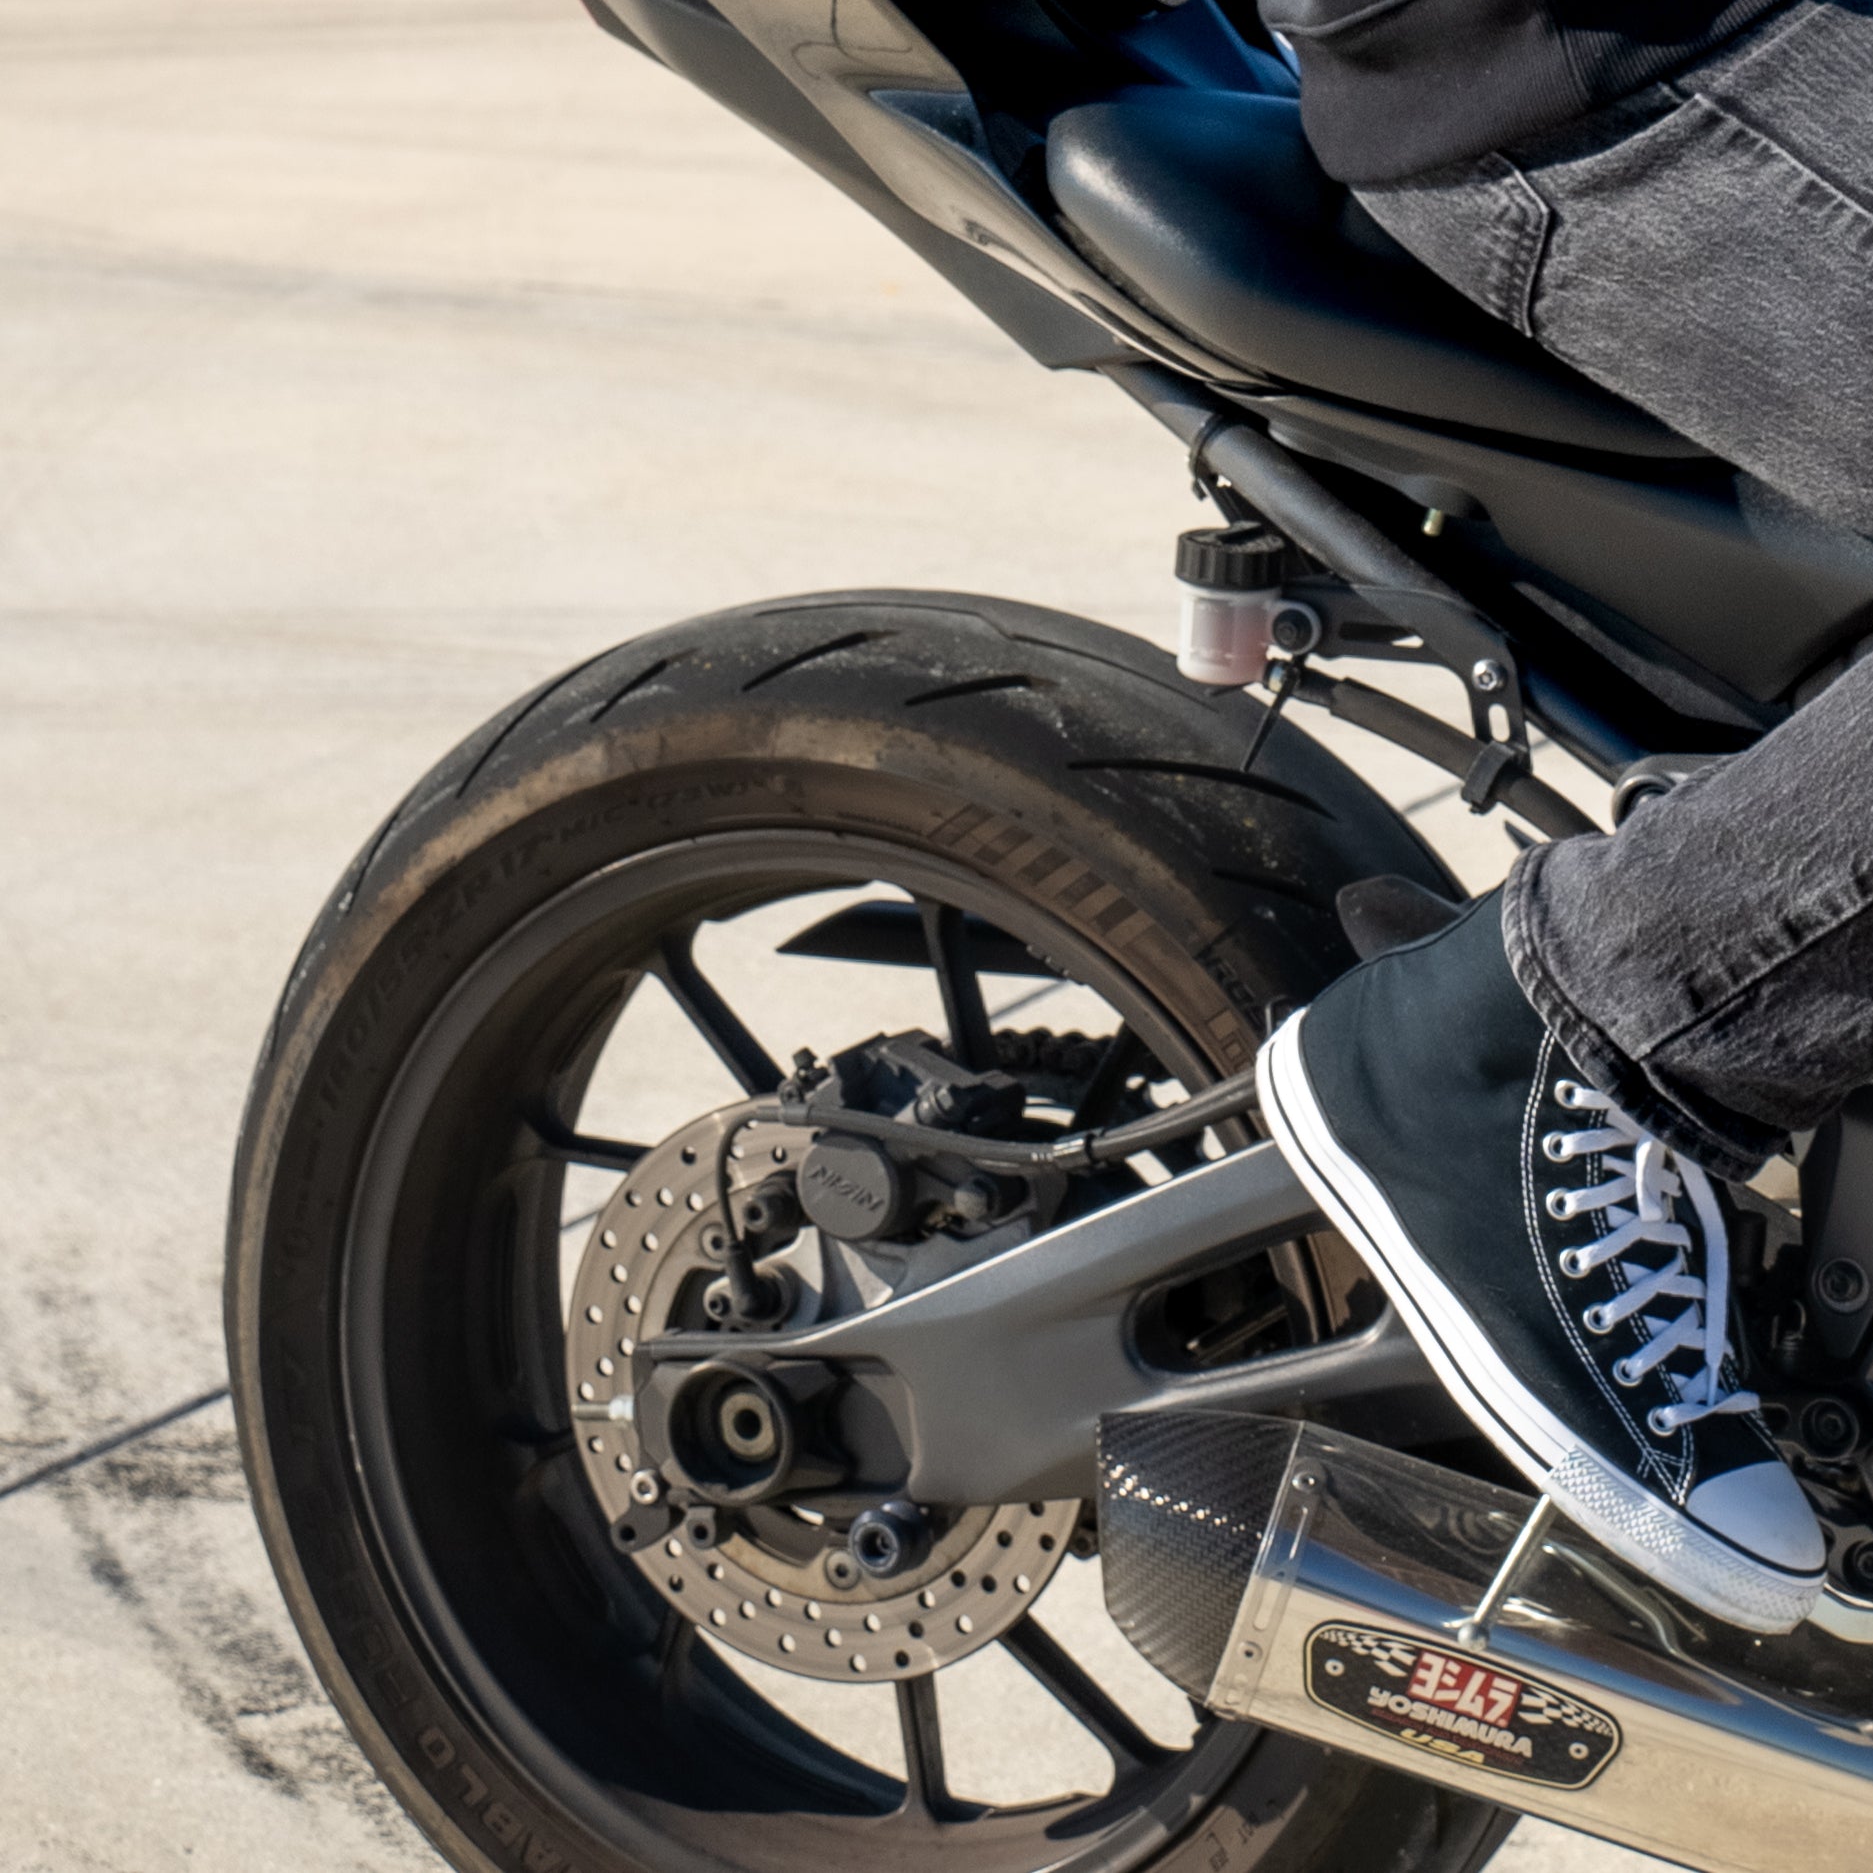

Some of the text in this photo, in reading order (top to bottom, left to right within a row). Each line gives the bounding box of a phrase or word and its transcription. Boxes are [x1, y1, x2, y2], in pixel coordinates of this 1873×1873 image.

[1366, 1685, 1533, 1759] YOSHIMURA
[1409, 1652, 1518, 1722] ヨシムラ
[1399, 1727, 1485, 1764] USA
